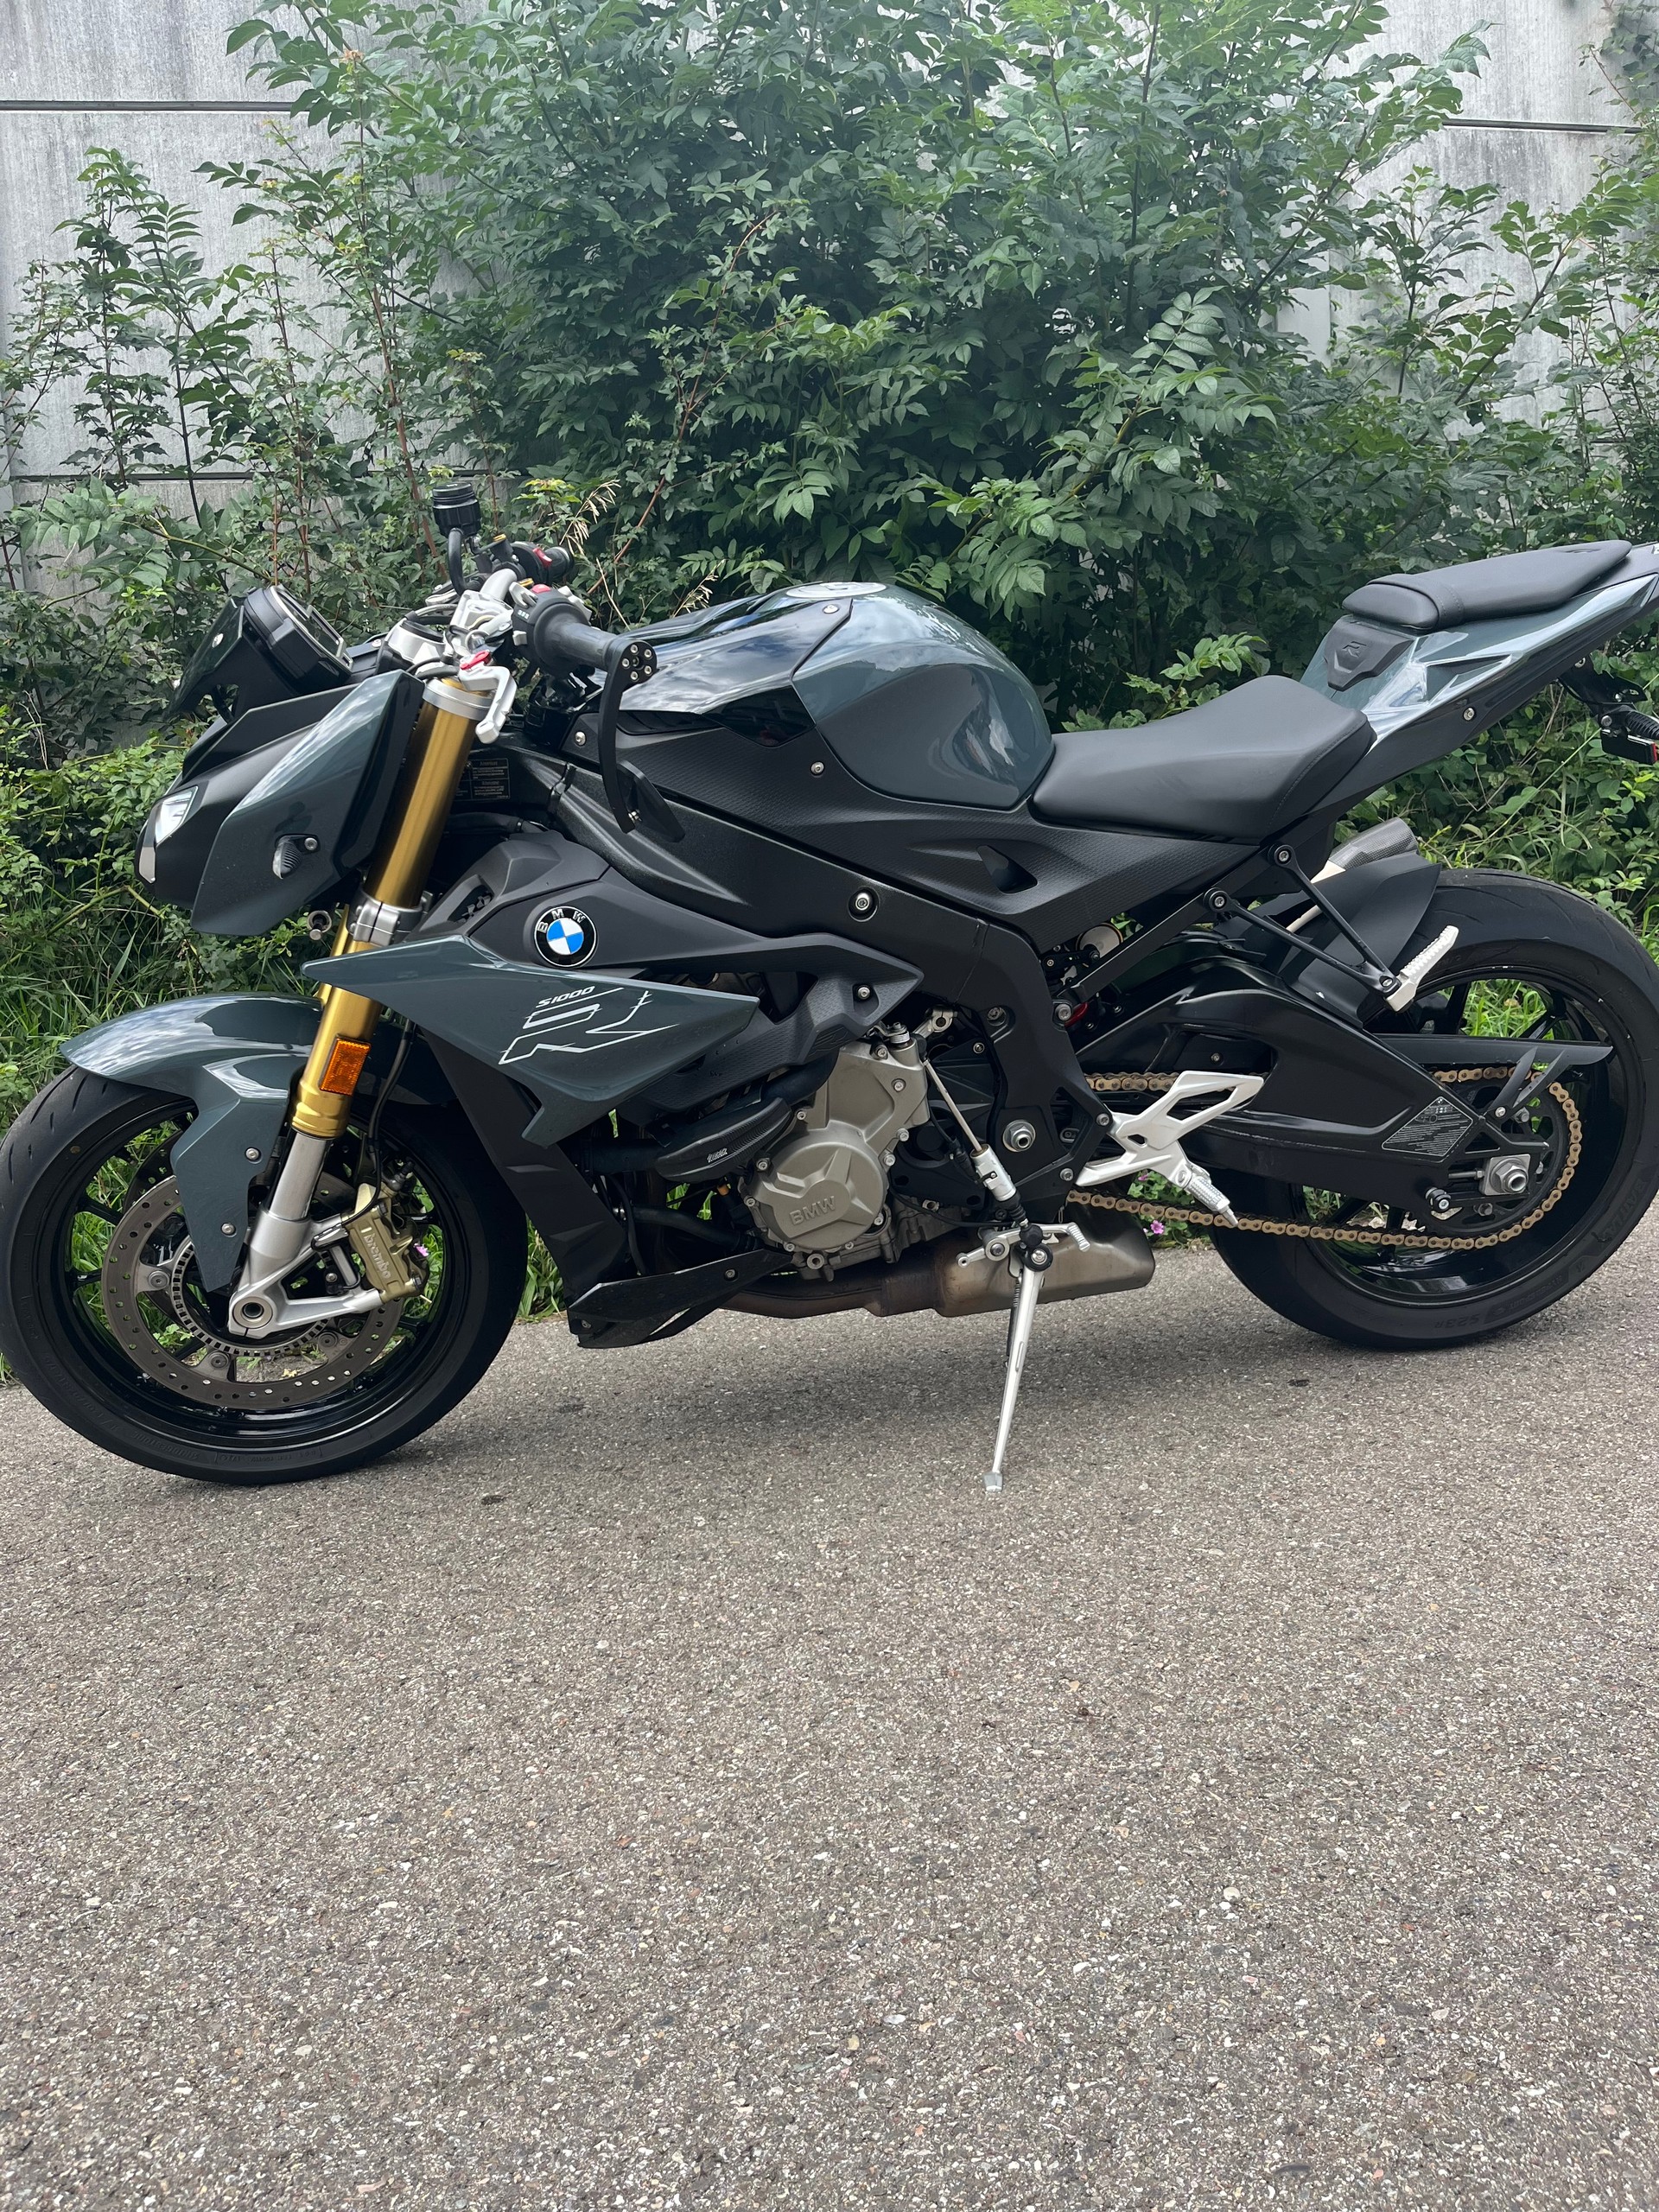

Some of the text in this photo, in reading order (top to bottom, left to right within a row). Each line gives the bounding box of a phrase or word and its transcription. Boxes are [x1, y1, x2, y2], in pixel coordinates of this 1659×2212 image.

[537, 908, 587, 933] BMW
[536, 985, 595, 1008] S1000
[790, 1195, 836, 1226] BMW
[363, 1232, 391, 1279] brembo
